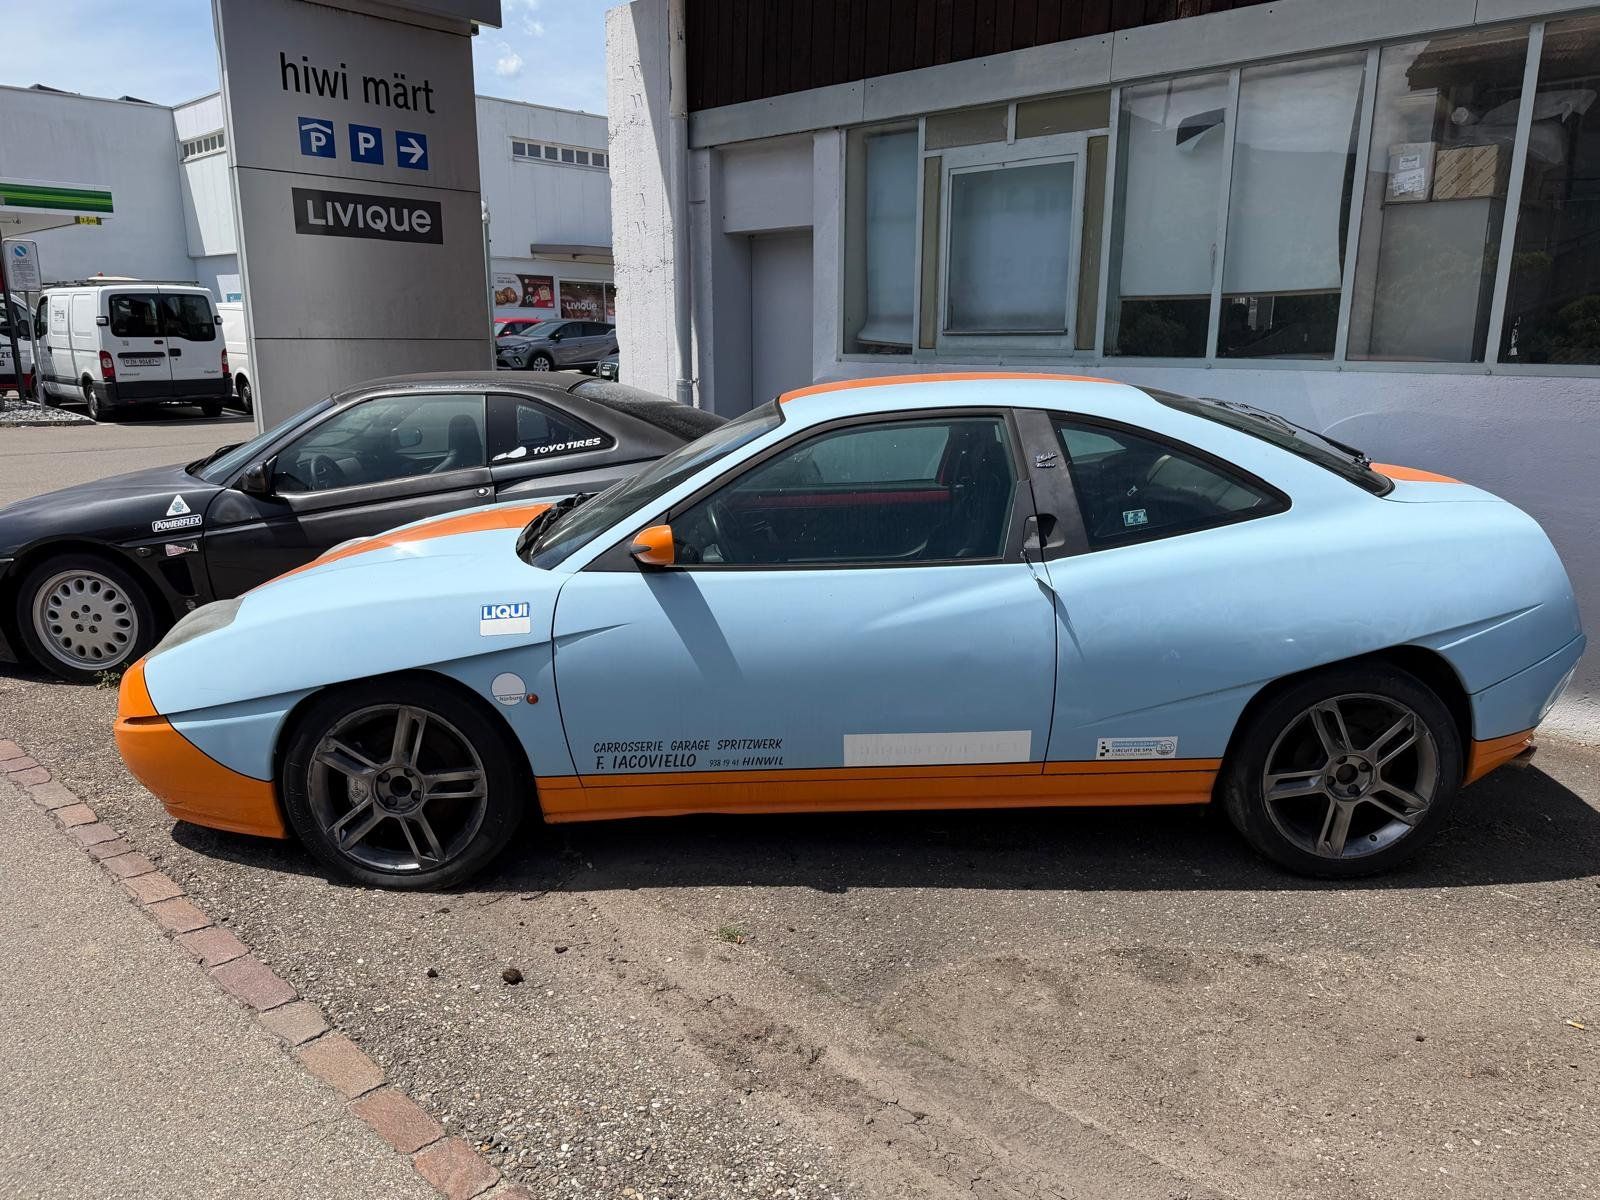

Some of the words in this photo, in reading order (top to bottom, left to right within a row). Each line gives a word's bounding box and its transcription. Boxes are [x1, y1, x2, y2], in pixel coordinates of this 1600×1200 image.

[280, 52, 349, 100] hiwi
[362, 73, 435, 114] märt
[310, 132, 327, 152] P
[358, 132, 376, 156] P
[532, 444, 565, 455] TOYO
[566, 437, 601, 450] TIRES
[155, 517, 200, 531] POWERFLEX
[482, 603, 529, 620] LIQUI
[593, 740, 663, 753] CARROSSERIE
[670, 739, 710, 751] GARAGE
[717, 738, 783, 751] SPRITZWERK
[596, 756, 605, 770] F.
[612, 753, 697, 769] IACOVIELLO
[742, 756, 784, 767] HINWIL
